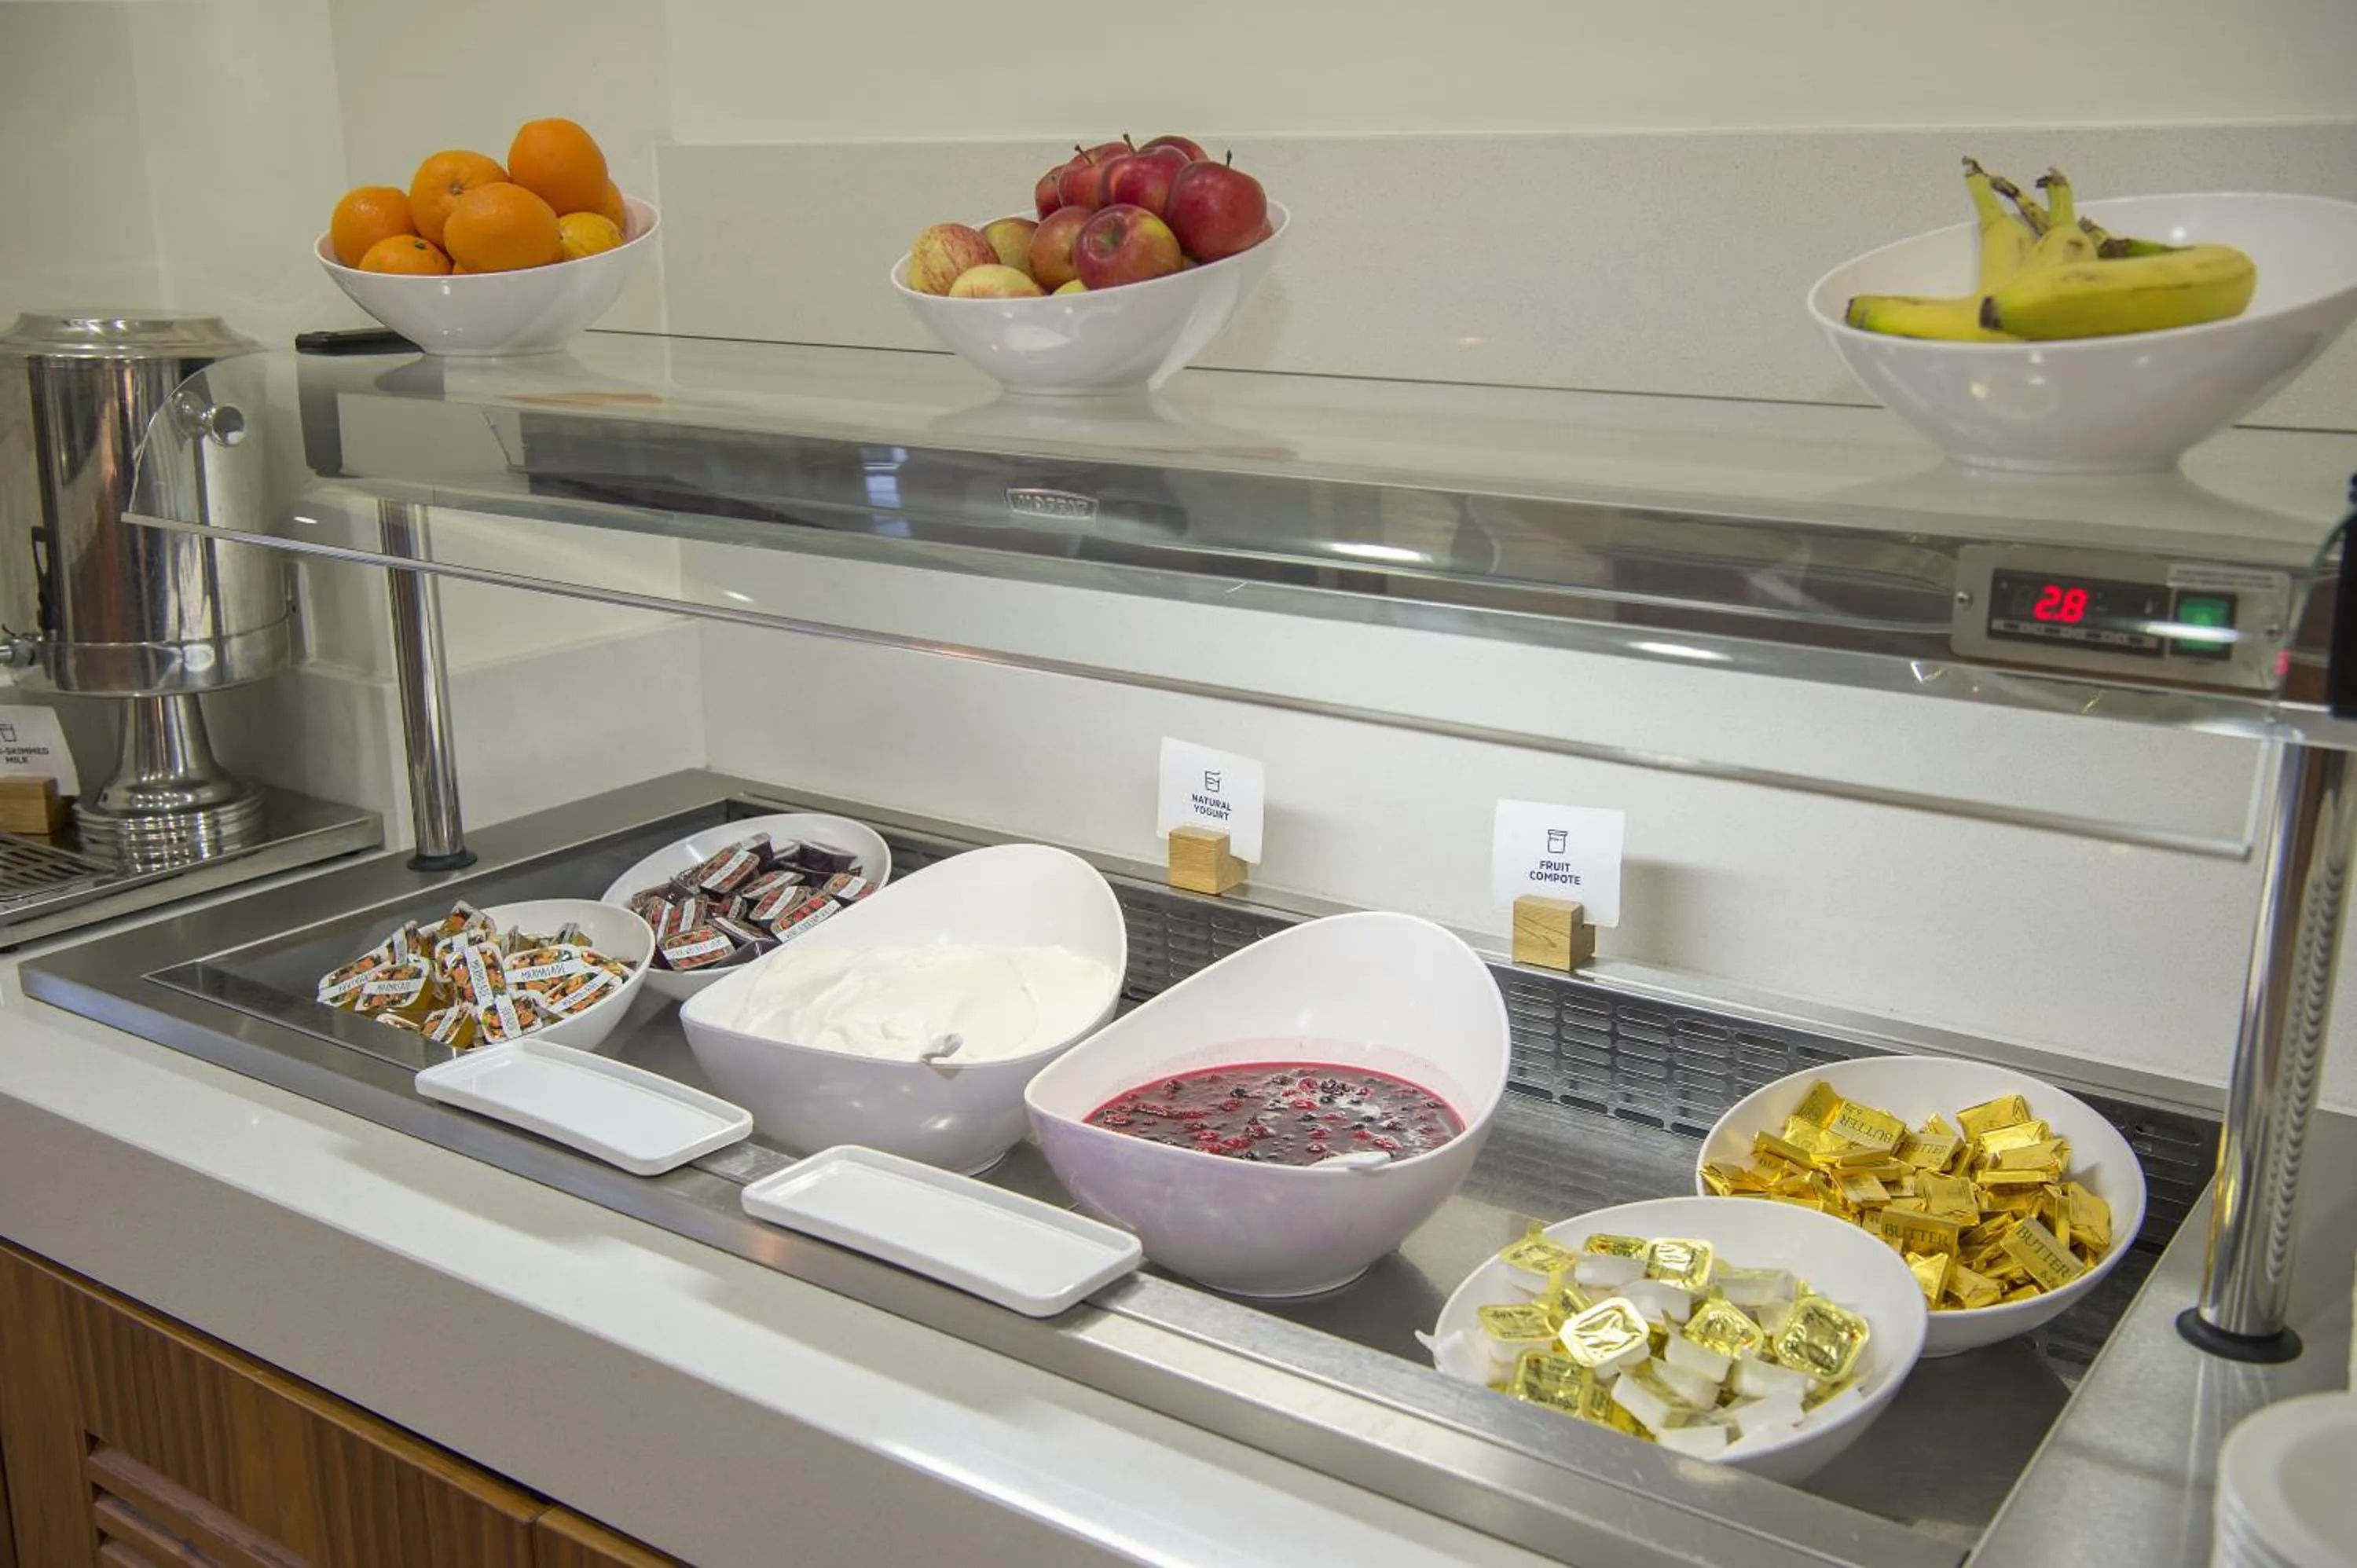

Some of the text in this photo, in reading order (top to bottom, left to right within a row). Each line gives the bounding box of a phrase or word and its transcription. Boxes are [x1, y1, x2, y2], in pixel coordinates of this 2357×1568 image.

[1192, 793, 1232, 811] NATURAL
[1193, 804, 1230, 821] YOGURT
[1539, 860, 1571, 873] FRUIT
[1530, 870, 1582, 885] COMPOTE
[1838, 1113, 1894, 1143] BUTTER
[1885, 1223, 1949, 1247] BUTTER
[2015, 1225, 2069, 1278] BUTTER
